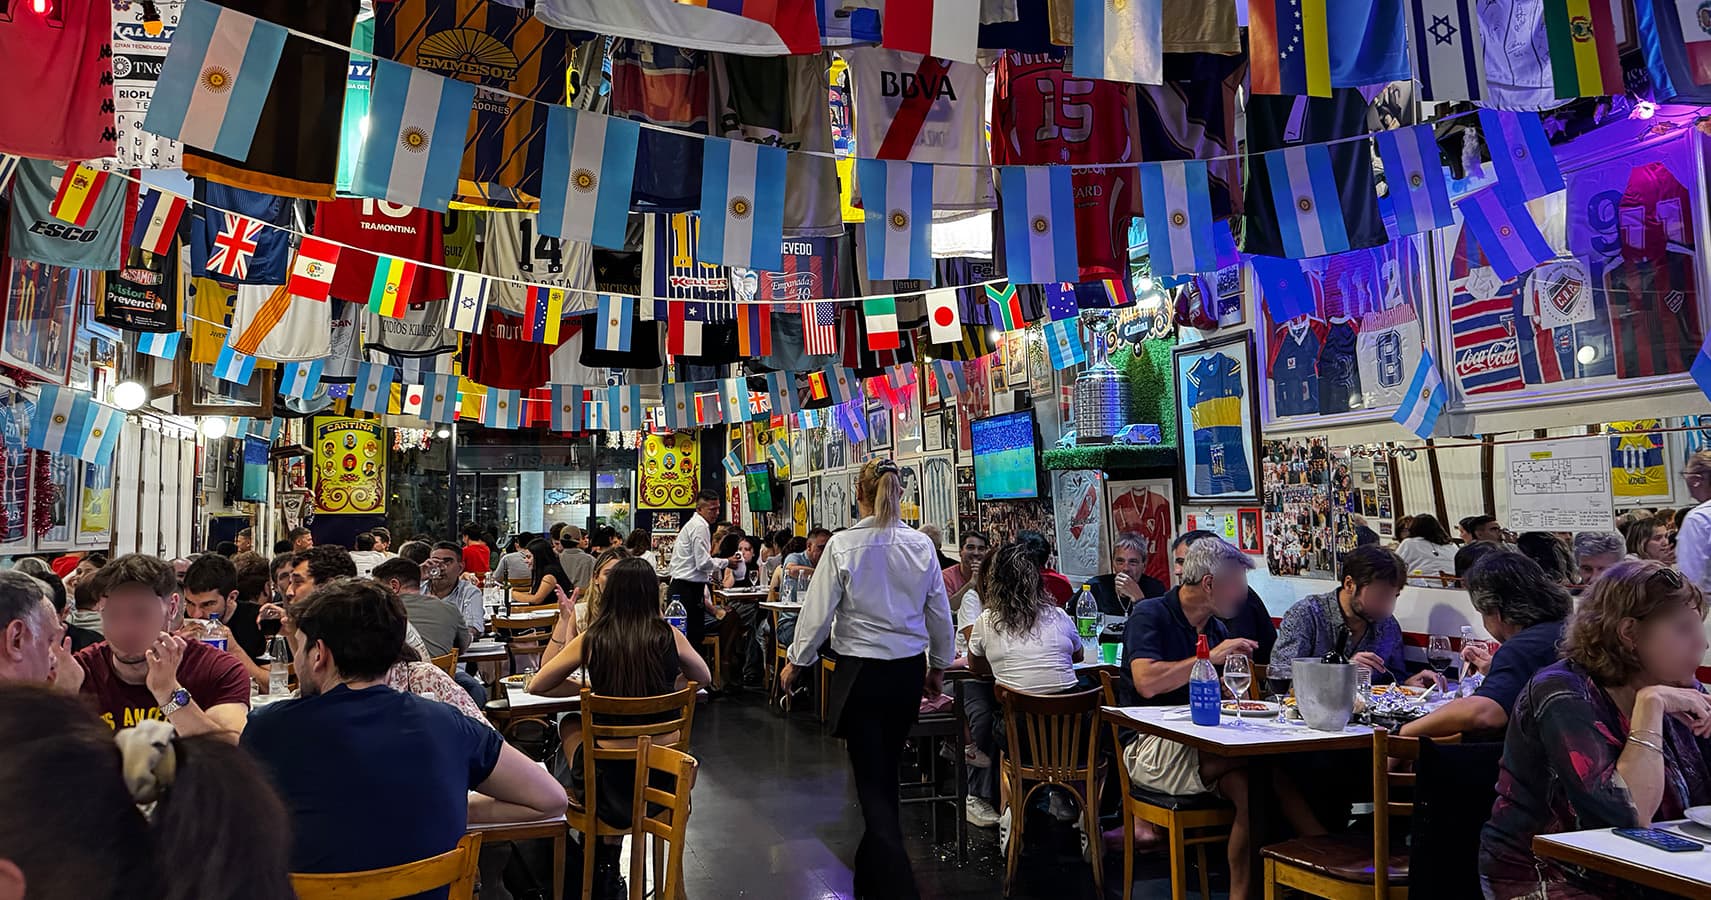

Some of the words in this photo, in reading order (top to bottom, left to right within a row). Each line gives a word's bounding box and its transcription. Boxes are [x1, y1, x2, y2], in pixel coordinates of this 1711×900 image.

[418, 56, 516, 81] EMMESOL
[119, 90, 152, 99] RIOPL
[881, 71, 957, 101] BBVA
[1036, 79, 1095, 142] 15
[27, 220, 100, 243] ESCO
[360, 221, 417, 235] TRAMONTINA
[519, 218, 563, 273] 14
[781, 242, 812, 256] EVEDO
[771, 275, 815, 294] Empanadas
[326, 421, 374, 432] CANTINA
